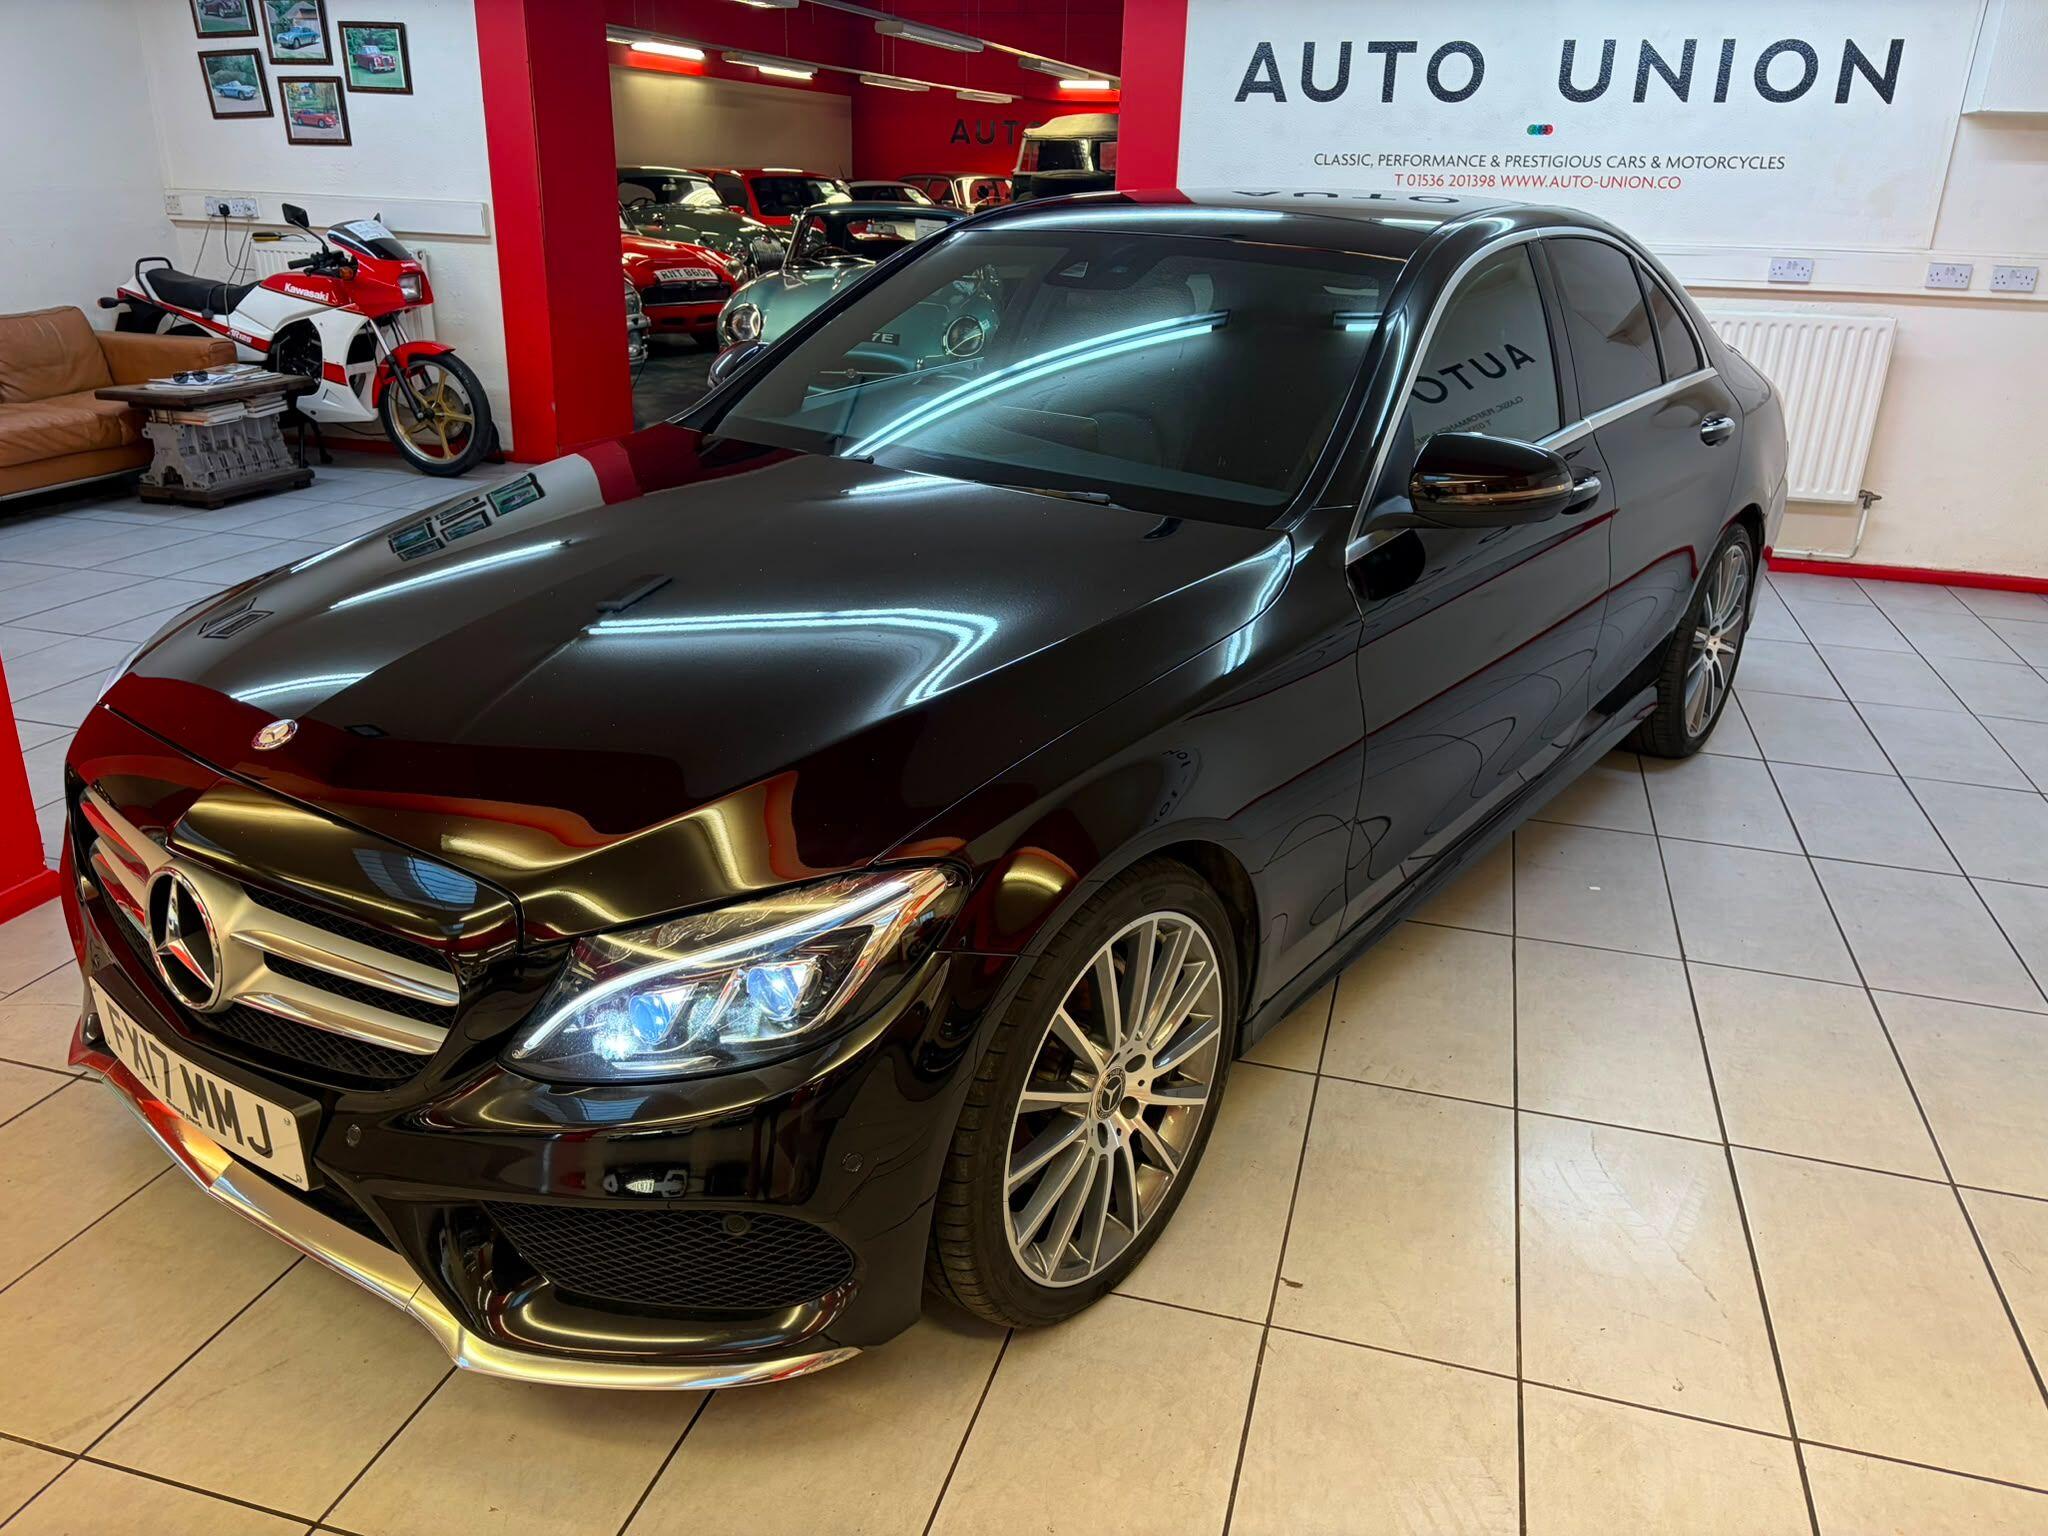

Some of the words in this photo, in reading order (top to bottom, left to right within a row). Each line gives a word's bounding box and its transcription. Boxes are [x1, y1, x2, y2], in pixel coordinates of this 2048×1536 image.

[1234, 39, 1485, 103] AUTO
[1557, 38, 1906, 104] UNION
[950, 118, 1042, 145] AUT
[1313, 153, 1374, 168] CLASSIC,
[1378, 154, 1487, 167] PERFORMANCE
[1490, 155, 1501, 167] &
[1504, 155, 1602, 168] PRESTIGIOUS
[1606, 155, 1646, 168] CARS
[1650, 156, 1662, 168] &
[1666, 156, 1786, 170] MOTORCYCLES
[1395, 173, 1404, 186] T
[1407, 174, 1445, 187] 01536
[1449, 174, 1496, 187] 201398
[1500, 175, 1682, 189] WWW.AUTO-UNION.CO
[284, 282, 329, 302] Kawasaki
[106, 999, 172, 1100] FX17
[179, 1063, 274, 1159] MMJ
